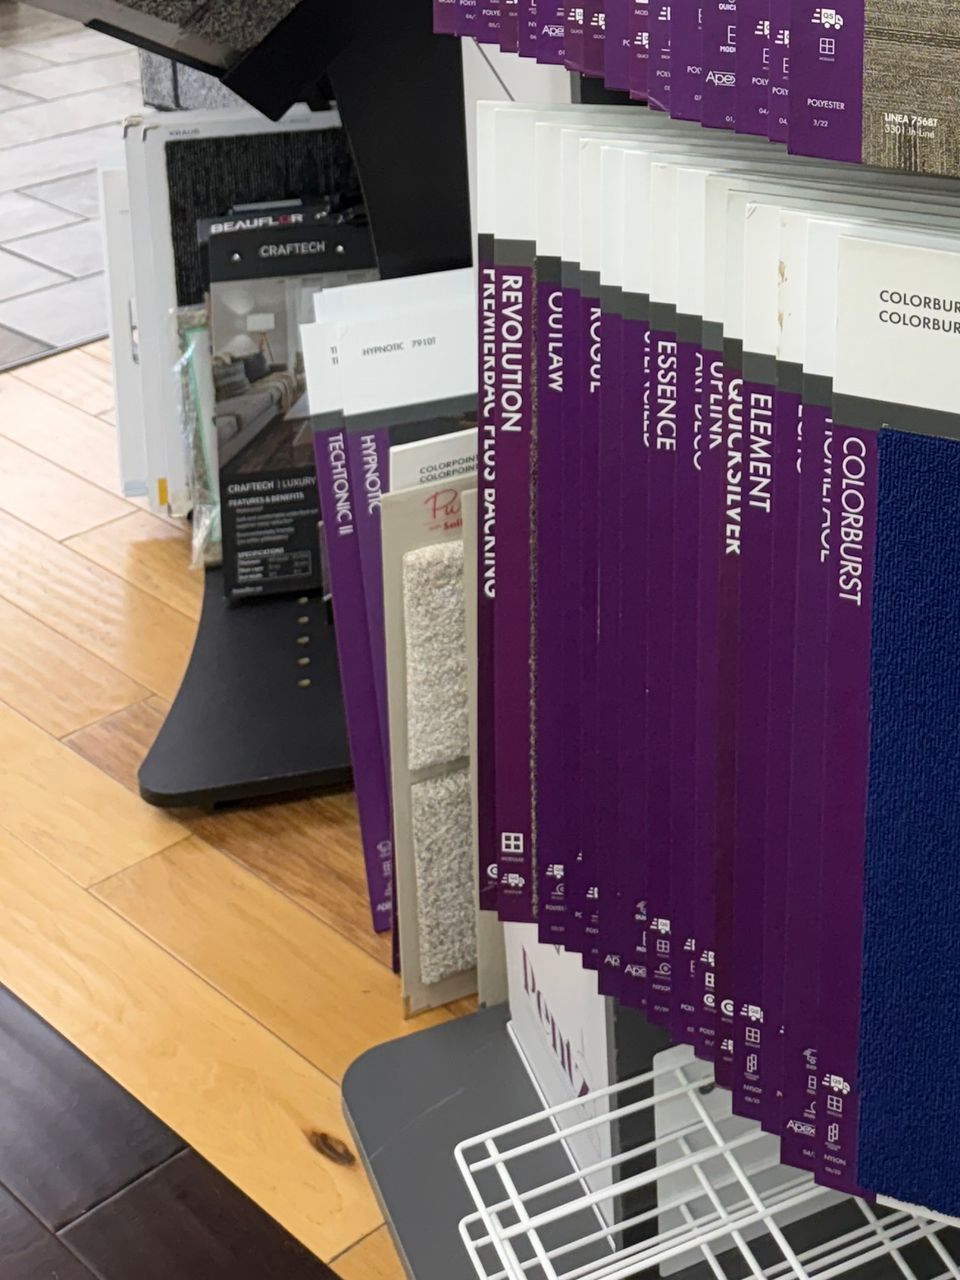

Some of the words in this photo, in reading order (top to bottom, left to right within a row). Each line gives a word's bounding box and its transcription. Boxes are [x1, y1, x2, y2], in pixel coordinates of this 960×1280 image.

[807, 98, 845, 111] POLYESTER
[813, 119, 828, 128] 3/22
[884, 113, 909, 124] LINEA
[911, 115, 938, 128] 7568T
[884, 124, 905, 135] 3301
[210, 213, 304, 234] BEAUFLOR
[260, 241, 326, 258] CRAFTECH
[362, 342, 404, 356] HYPNOTIC
[501, 274, 523, 432] REVOLUTION
[656, 340, 677, 451] ESSENCE
[749, 392, 772, 513] ELEMENT
[360, 434, 381, 514] HYPNOTIC
[725, 378, 743, 555] QUICKSILVER
[228, 480, 274, 494] CRAFTECH
[282, 477, 317, 489] LUXURY
[328, 432, 353, 522] TECHTONIC
[228, 496, 264, 507] FEATURES
[271, 492, 305, 503] BENEFITS
[838, 436, 866, 606] COLORBURST
[338, 525, 354, 536] II
